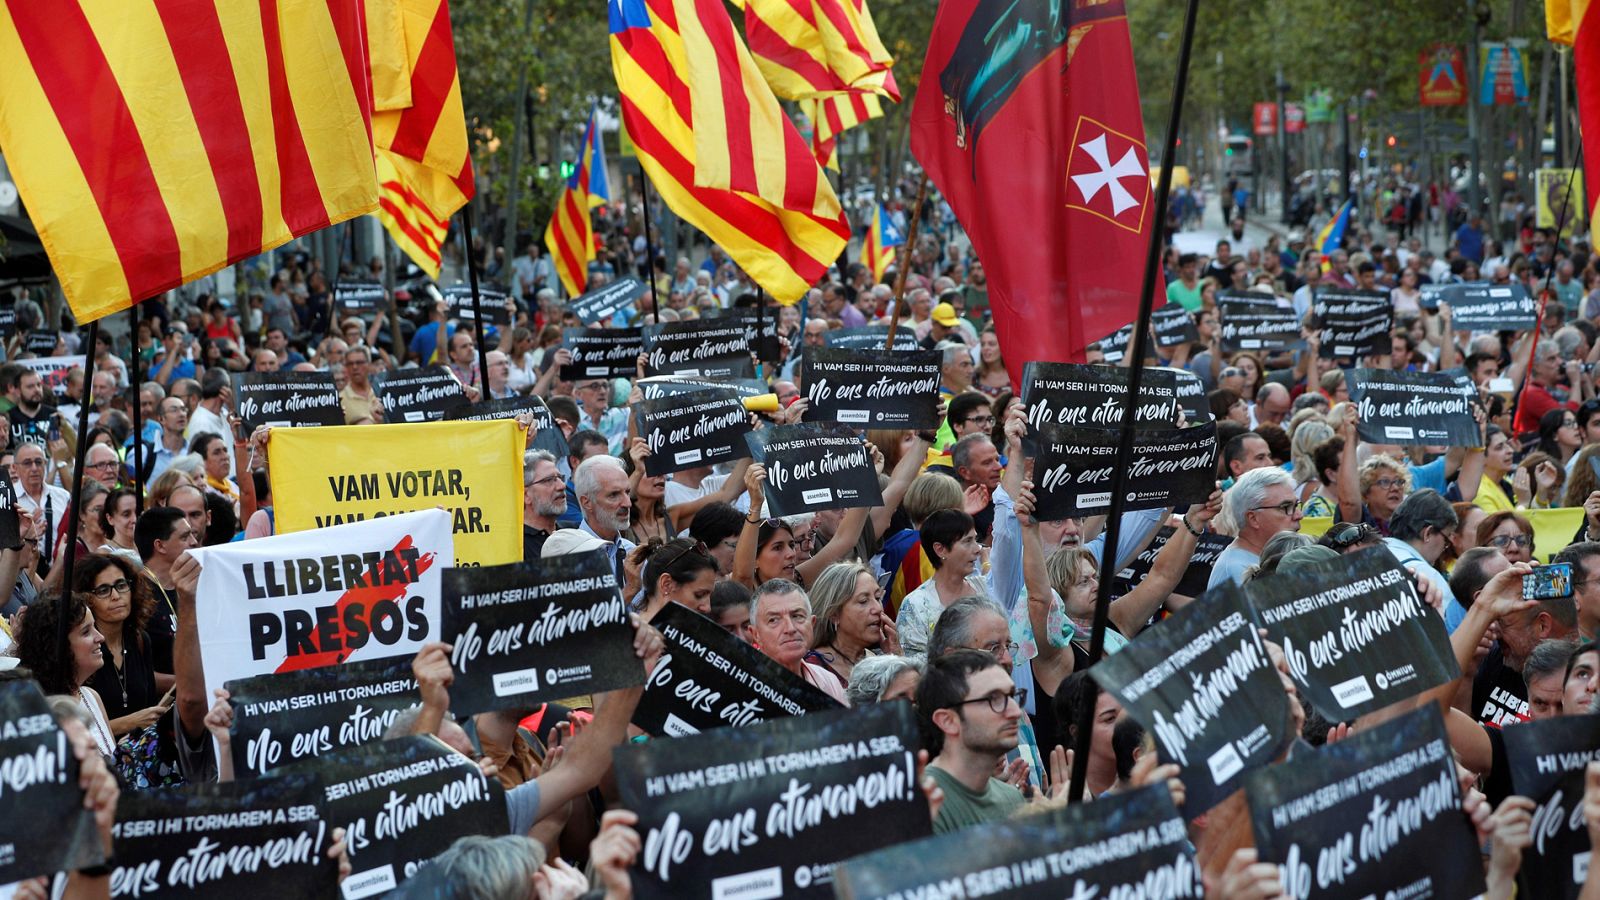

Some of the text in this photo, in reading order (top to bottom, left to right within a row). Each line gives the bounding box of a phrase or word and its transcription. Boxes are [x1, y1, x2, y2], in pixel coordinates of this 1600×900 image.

[658, 333, 674, 341] VAM
[674, 332, 687, 340] SER
[697, 329, 730, 338] TORNAREM
[649, 336, 750, 370] No ens aturarem!
[813, 362, 924, 373] HI VAM SER HI TORNAREM A
[248, 383, 264, 391] VAM
[264, 383, 277, 391] SER
[382, 383, 463, 413] No ens aturarem!
[808, 372, 941, 406] No ens aturarem!
[1034, 380, 1173, 397] HI VAM SER HI A SER.
[1356, 382, 1366, 390] HI
[1366, 382, 1381, 390] VAM
[1382, 383, 1396, 391] SER
[1407, 384, 1443, 394] TORNAREM
[240, 390, 339, 421] No ens aturarem!
[654, 411, 670, 420] VAM
[670, 408, 684, 417] SER
[694, 401, 725, 412] TORNAREM
[1028, 398, 1087, 431] No ens
[1358, 395, 1468, 423] No ens aturarem!
[647, 405, 747, 454] No ens aturarem!
[762, 437, 846, 453] HI VAM SER HI TORNAREM
[1051, 442, 1198, 455] HI VAM SER TORNAREM A
[328, 468, 470, 502] VAM VOTAR,
[768, 445, 869, 491] No ens aturarem!
[1041, 463, 1114, 493] No ens
[807, 492, 829, 500] assemblea
[1137, 490, 1169, 498] ÒMNIUM
[242, 547, 420, 600] LLIBERTAT
[461, 578, 596, 609] HI VAM SER HI TORNAREM
[1261, 569, 1406, 624] HI VAM SER HI TORNAREM A SER.
[249, 595, 430, 661] PRESOS
[451, 587, 626, 674] No ens aturarem!
[1309, 580, 1426, 669] ens aturarem!
[500, 675, 533, 688] assemblea
[557, 665, 592, 677] ÒMNIUM
[663, 625, 677, 641] HI
[678, 632, 707, 657] VAM
[705, 651, 731, 673] SER
[729, 665, 736, 676] I
[735, 669, 749, 683] HI
[749, 675, 806, 718] TORNAREM
[1386, 664, 1415, 681] ÒMNIUM
[244, 678, 411, 717] HI VAM SER HI TORNAREM
[675, 678, 720, 712] ens
[1152, 709, 1189, 767] No
[1190, 622, 1269, 720] aturarem!
[247, 728, 282, 774] No
[291, 725, 333, 758] ens
[1537, 752, 1593, 774] HI VAM
[356, 757, 438, 793] HI TORNAREM
[645, 778, 665, 798] HI
[666, 771, 704, 794] VAM
[705, 764, 740, 787] SER
[747, 758, 765, 777] HI
[765, 742, 855, 775] TORNAREM
[854, 741, 869, 759] A
[375, 773, 490, 840] aturarem!
[1272, 750, 1418, 830] HI VAM SER HI TORNAREM
[123, 819, 156, 838] SER
[164, 818, 181, 834] HI
[181, 809, 271, 832] TORNAREM
[270, 808, 283, 823] A
[643, 751, 914, 882] No ens aturarem!
[1317, 757, 1461, 889] ens aturarem!
[1529, 790, 1565, 855] No
[168, 820, 326, 888] aturarem!
[964, 828, 1147, 898] SER HI TORNAREM
[350, 873, 389, 893] assemblea
